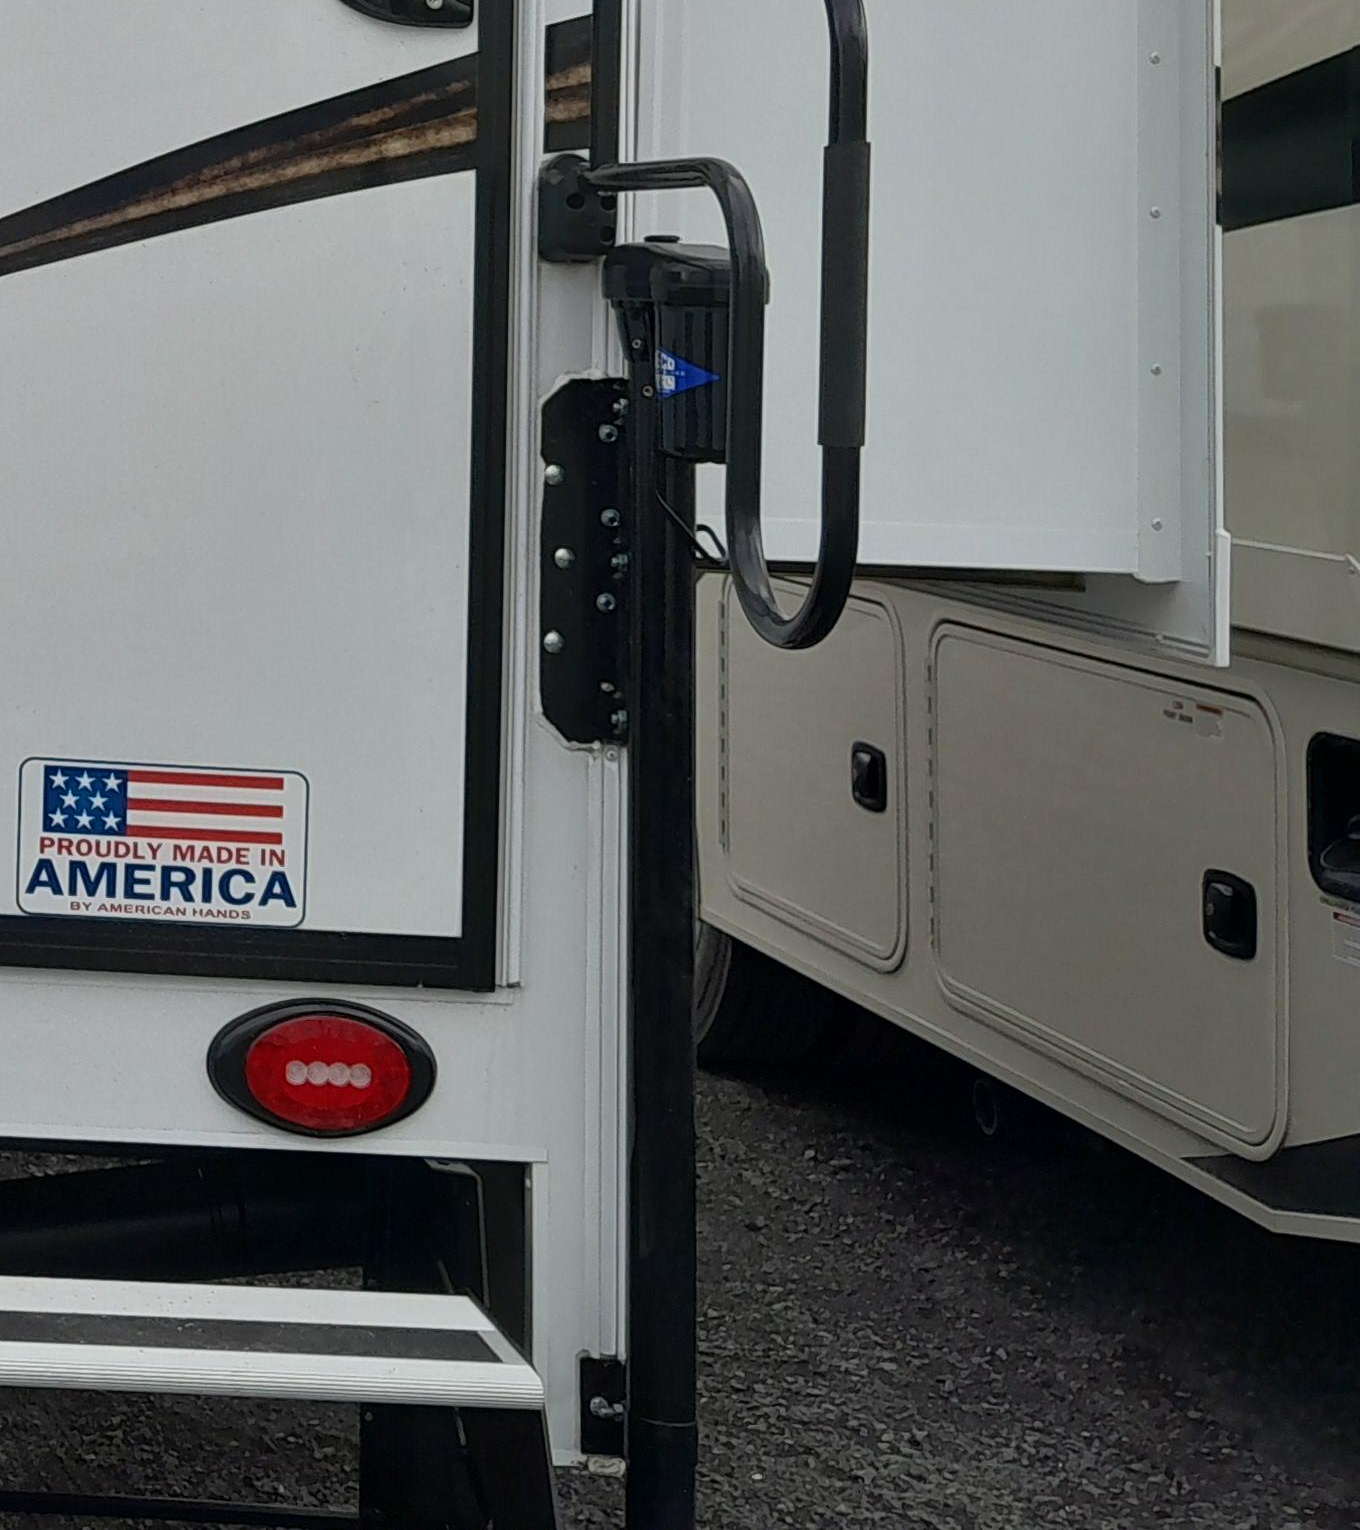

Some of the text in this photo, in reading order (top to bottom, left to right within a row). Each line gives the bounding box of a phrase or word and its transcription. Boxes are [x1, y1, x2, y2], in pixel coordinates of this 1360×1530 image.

[38, 836, 286, 868] PROUDLY MADE IN
[24, 857, 298, 909] AMERICA
[69, 901, 251, 920] BY AMERICAN HANDS
